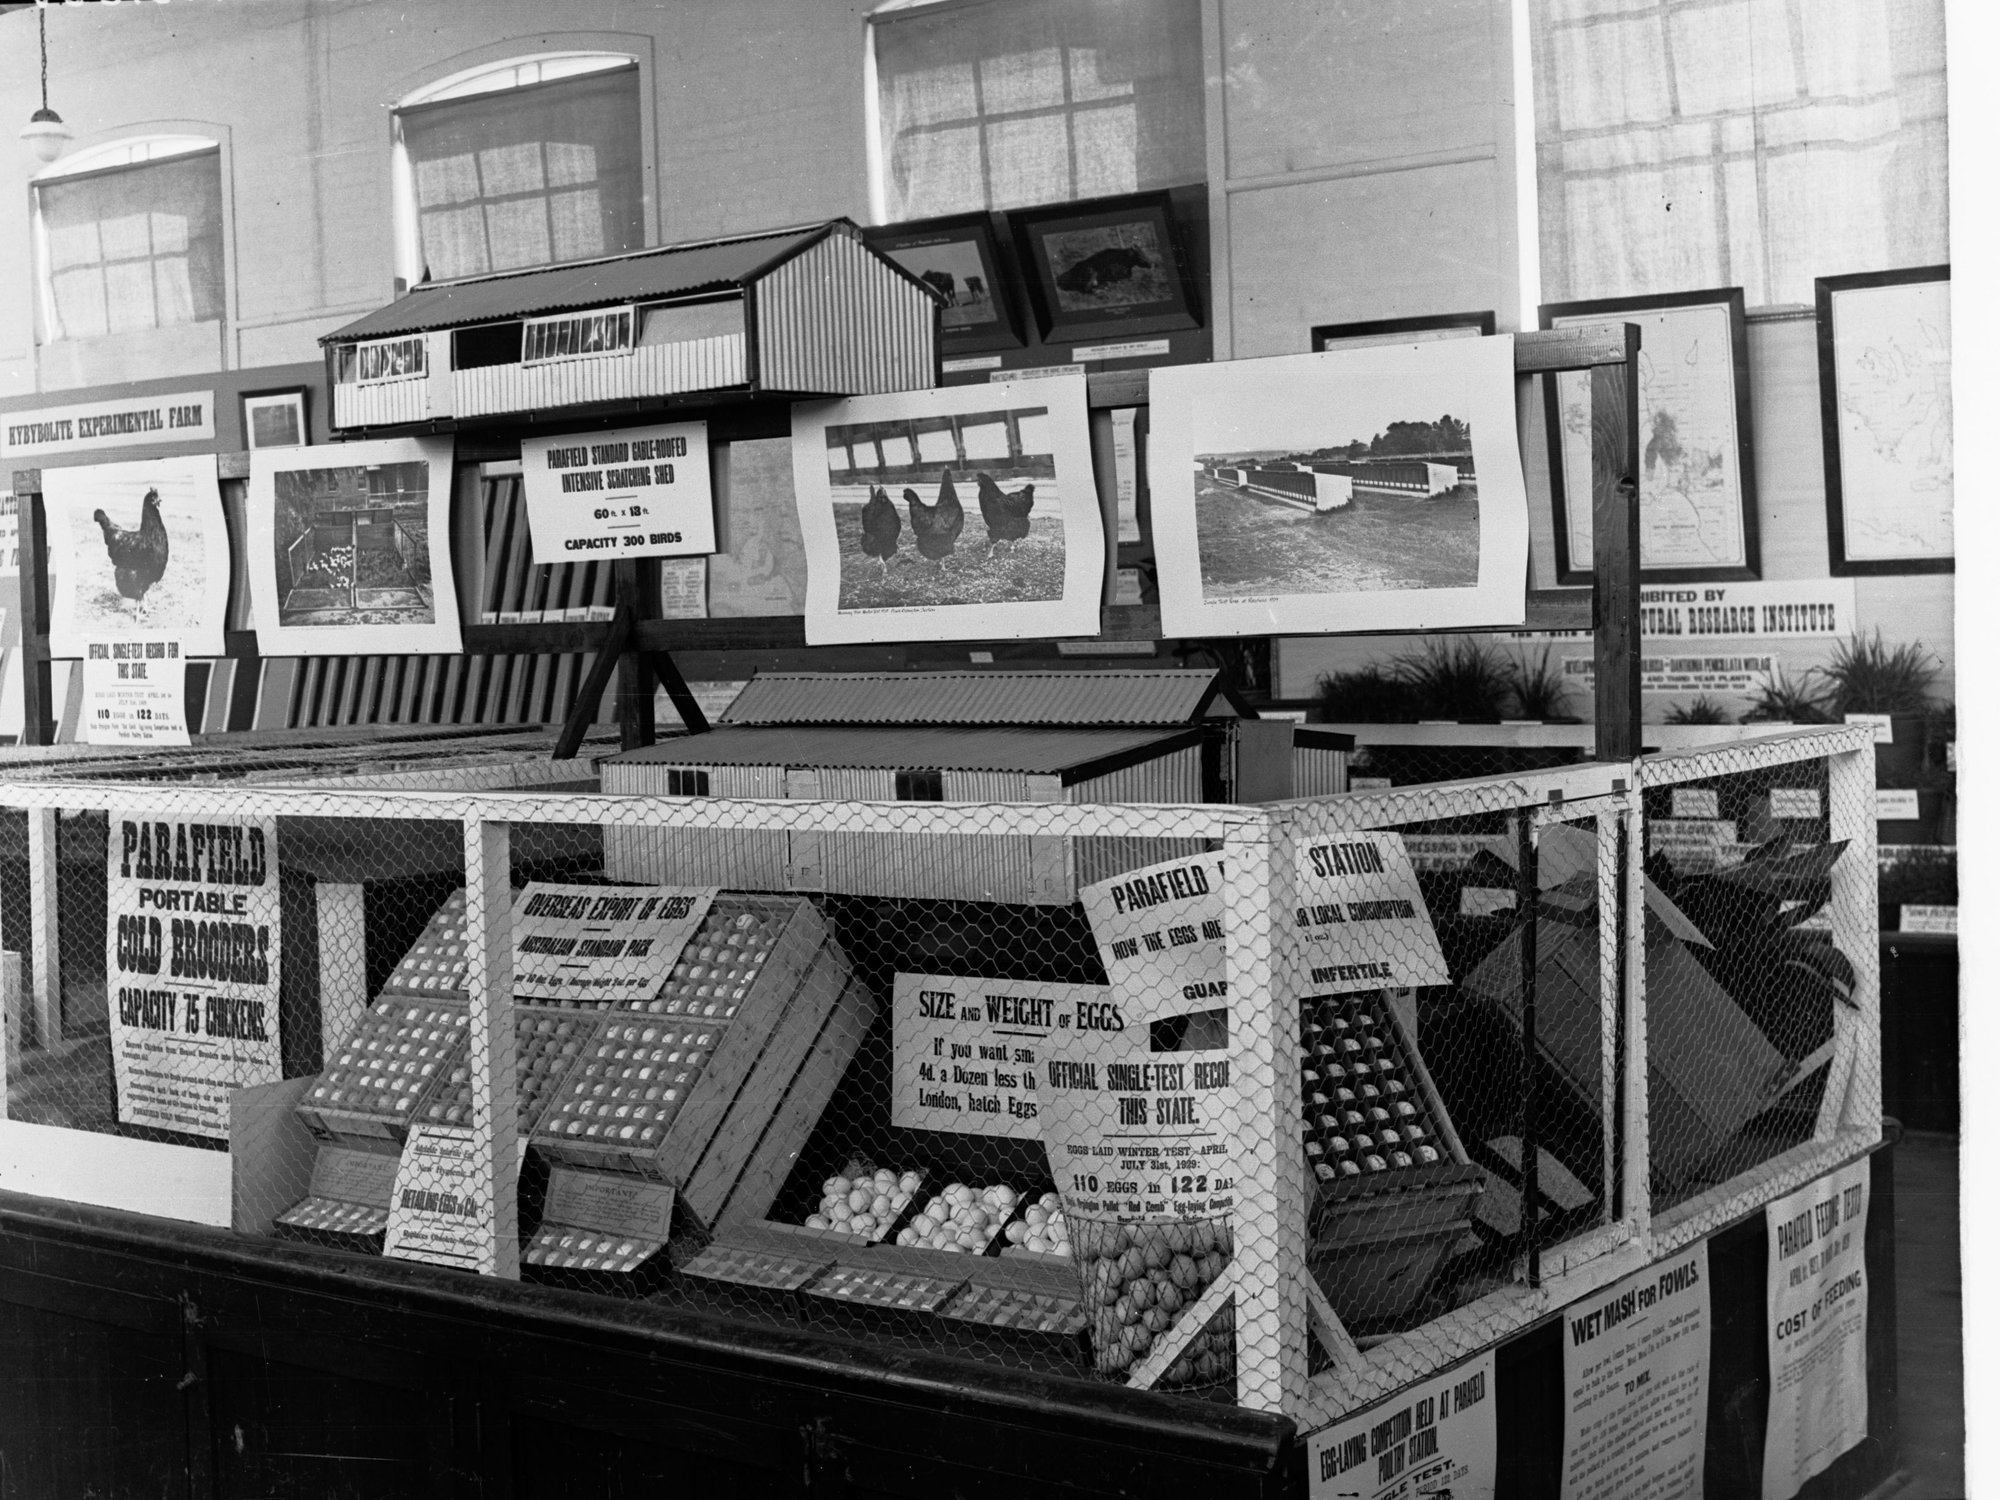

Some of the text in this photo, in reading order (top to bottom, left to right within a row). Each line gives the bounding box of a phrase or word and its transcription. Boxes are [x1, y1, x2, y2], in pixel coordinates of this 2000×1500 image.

[9, 405, 203, 446] KYBYBOLITE EXPERIMENTAL FARM
[547, 437, 687, 469] PARAFIELD STANDARD GABLE-ROOFED
[562, 464, 675, 493] INTENSIVE SCRATCHING SHED
[594, 508, 609, 519] 60
[564, 532, 682, 550] CAPACITY 300 BIRDS
[1704, 589, 1726, 601] BY
[1689, 606, 1755, 634] RESEARCH
[1763, 603, 1835, 632] INSTITUTE
[89, 643, 109, 660] OFFICIAL
[113, 642, 143, 659] SINGLE-TEST
[168, 641, 179, 659] FOR
[118, 663, 129, 679] THIS
[97, 709, 110, 719] 110
[137, 709, 152, 719] 122
[120, 820, 266, 887] PARAFIELD
[1308, 842, 1385, 878] STATION
[139, 888, 248, 916] PORTABLE
[1110, 865, 1210, 914] PARAFIELD
[523, 893, 696, 921] OVERSEAS EXPORT OF EGGS
[1311, 899, 1416, 925] LOCAL CONSUMPTION
[117, 914, 269, 985] COLD BROODERS
[517, 935, 655, 958] AUSTRALIAN STANDARD PACK
[1111, 919, 1226, 960] HOW THE EGGS ARE
[1311, 962, 1393, 984] INFERTILE
[119, 987, 269, 1043] CAPACITY 75 CHICKENS.
[919, 990, 1125, 1032] SIZE AND WEIGHT OF EGGS
[934, 1037, 944, 1056] If
[950, 1043, 972, 1060] you
[978, 1045, 1008, 1062] want
[919, 1062, 935, 1082] 4d.
[940, 1068, 947, 1082] a
[953, 1065, 988, 1086] Dozen
[994, 1068, 1017, 1090] less
[1049, 1061, 1098, 1091] OFFICIAL
[1107, 1063, 1185, 1091] SINGLE-TEST
[919, 1088, 1038, 1119] London, hatch Eggs
[1118, 1096, 1200, 1125] THIS STATE.
[1067, 1144, 1089, 1155] EGGS
[1092, 1146, 1114, 1156] LAID
[1117, 1146, 1160, 1157] WINTER
[1200, 1144, 1228, 1155] APRIL
[1120, 1160, 1146, 1170] JULY
[1073, 1174, 1099, 1193] 110
[1106, 1181, 1138, 1194] EGGS
[1148, 1181, 1161, 1193] in
[1171, 1175, 1208, 1193] 122
[400, 1188, 439, 1213] RETAILING
[438, 1193, 458, 1214] EGGS
[1173, 1200, 1206, 1214] Egg-laying
[1571, 1260, 1699, 1347] WET MASH FOR FOWLS.
[1776, 1270, 1862, 1340] COST OF FEEDING
[1624, 1380, 1635, 1396] TO
[1320, 1370, 1485, 1482] EGG-LAYING COMPETITION HELD AT PARAFIELD
[1378, 1426, 1439, 1485] POULTRY STATION.
[1413, 1459, 1455, 1484] TEST.
